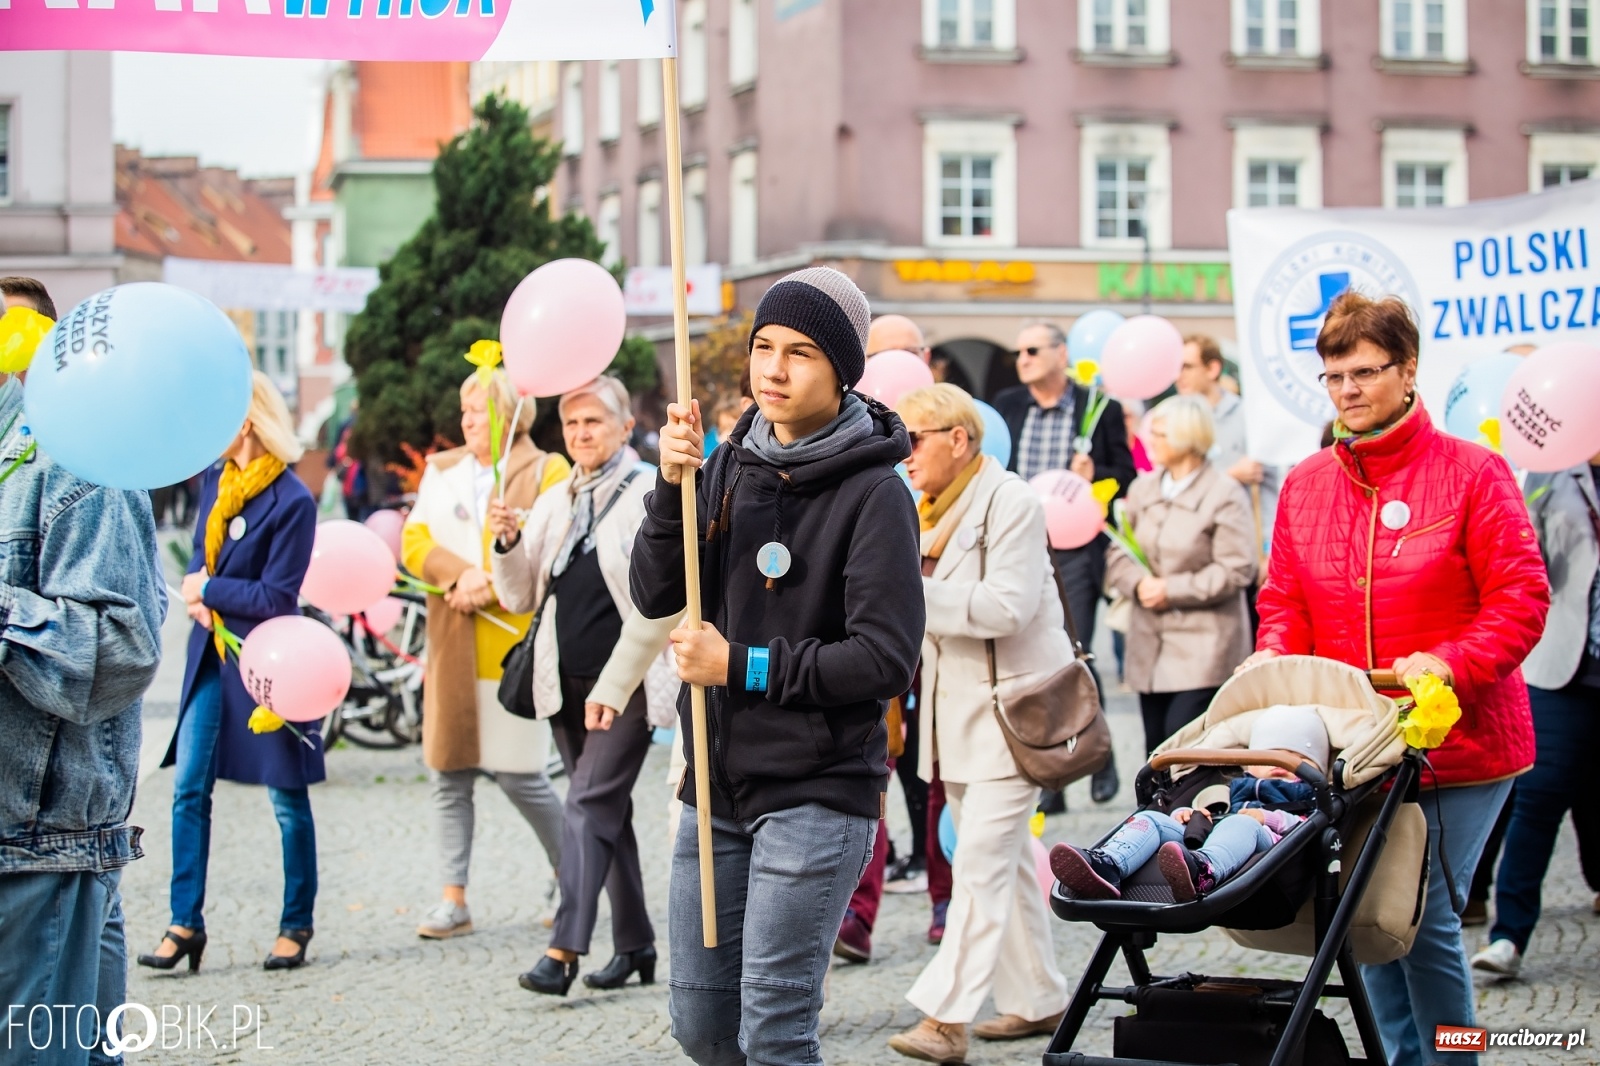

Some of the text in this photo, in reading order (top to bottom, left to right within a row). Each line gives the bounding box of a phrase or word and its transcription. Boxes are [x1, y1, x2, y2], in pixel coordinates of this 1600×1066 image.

[1455, 228, 1588, 280] POLSKI
[1096, 261, 1233, 298] KANT
[1513, 403, 1548, 438] PRZED
[1517, 387, 1563, 433] ZDĄŻYĆ
